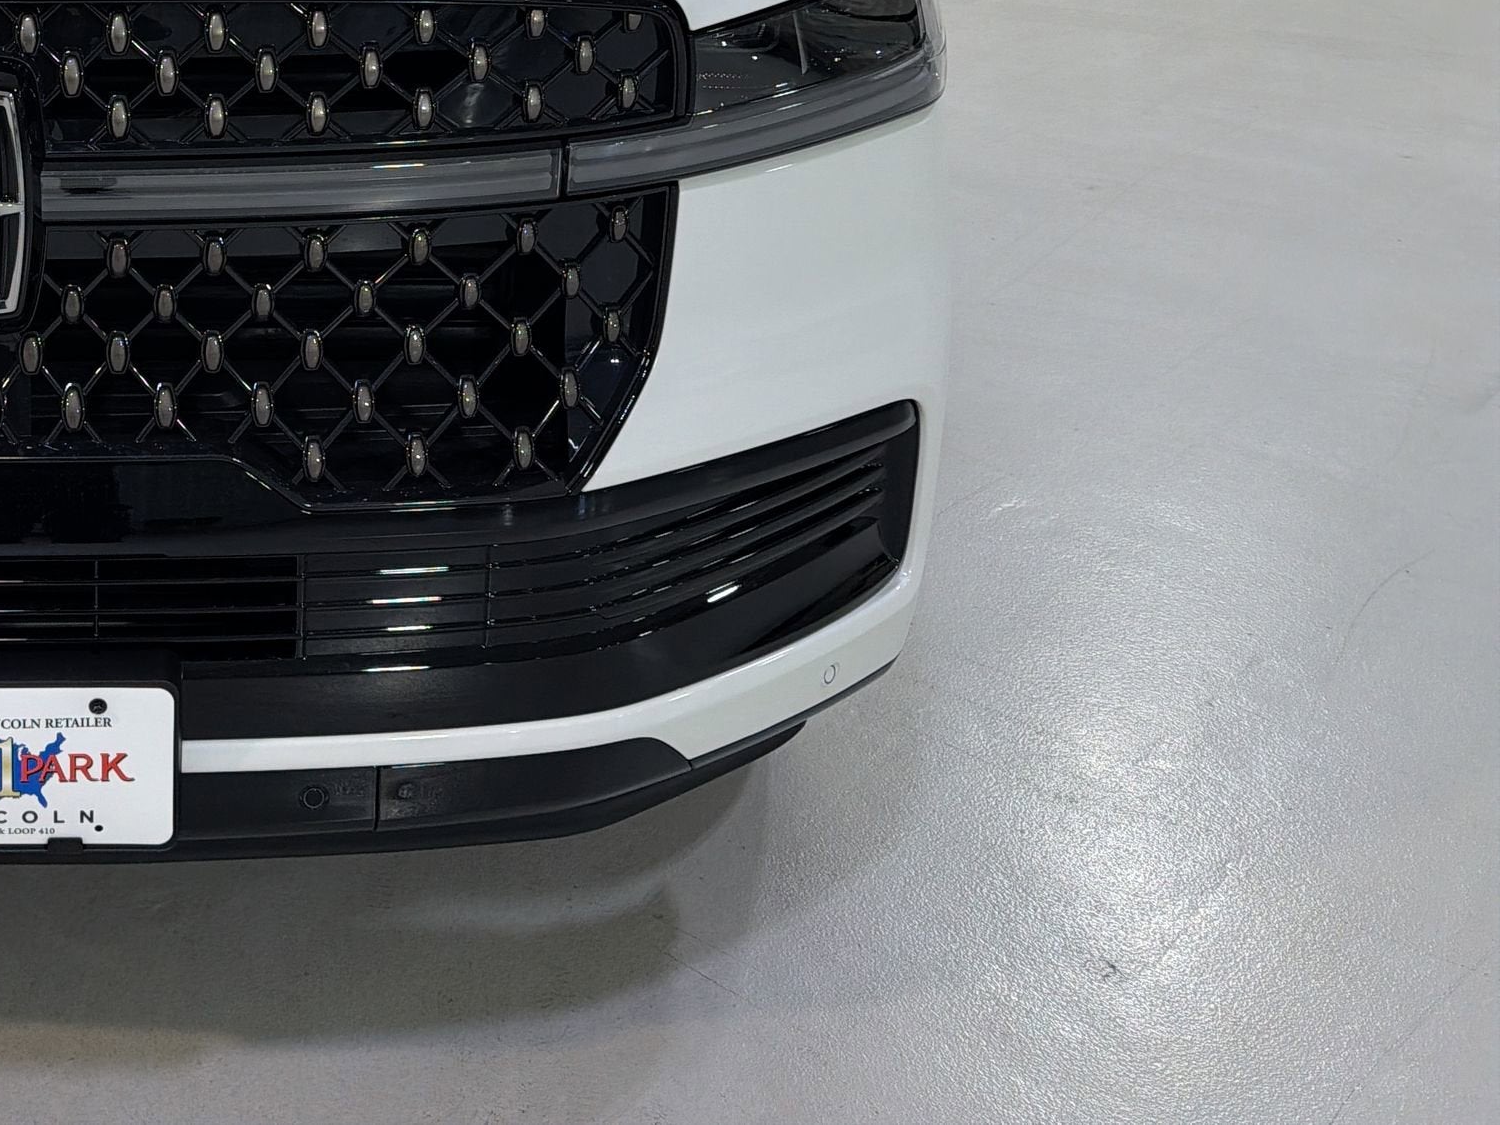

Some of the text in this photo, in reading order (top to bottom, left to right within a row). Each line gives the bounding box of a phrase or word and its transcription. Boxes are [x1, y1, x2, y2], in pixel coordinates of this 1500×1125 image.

[44, 716, 112, 728] RETAILER
[19, 752, 136, 784] PARK
[7, 827, 37, 835] LOOP
[38, 827, 56, 835] 410
